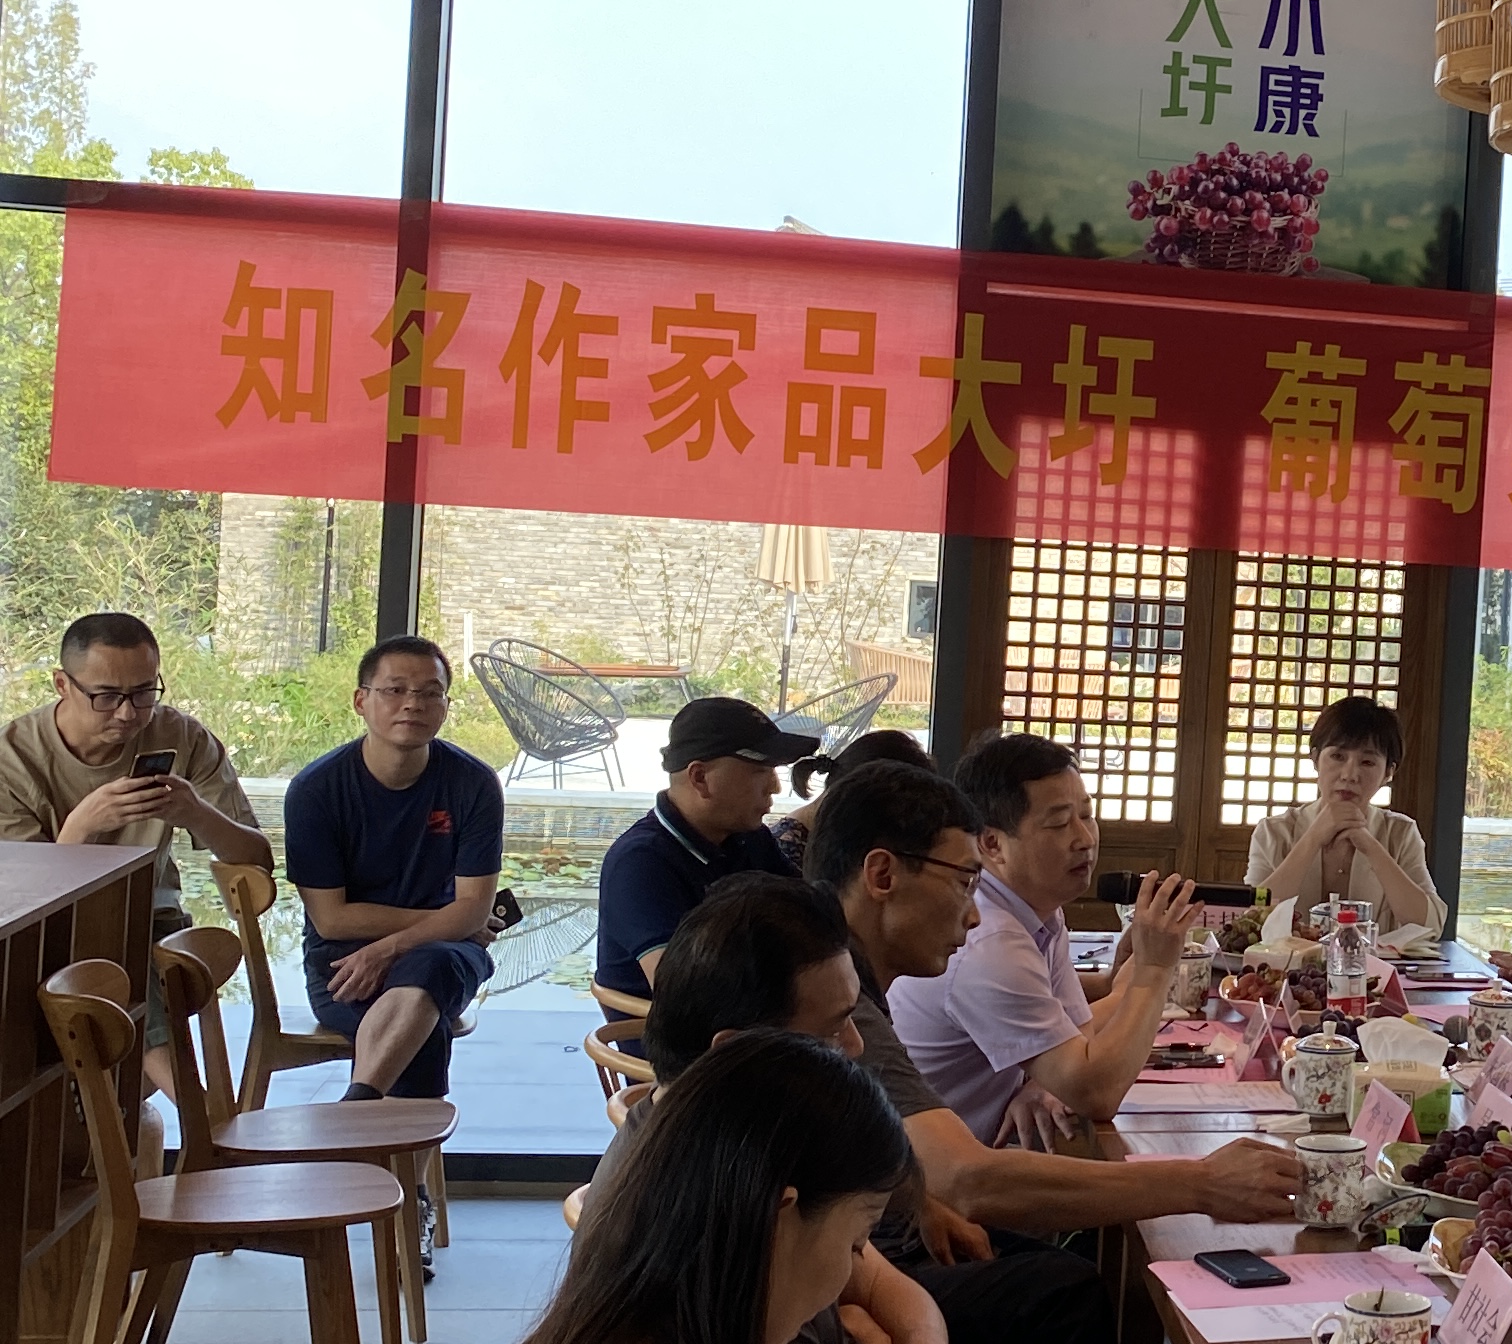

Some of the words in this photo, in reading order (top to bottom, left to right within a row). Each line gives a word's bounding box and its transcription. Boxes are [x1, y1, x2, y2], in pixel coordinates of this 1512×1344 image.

[214, 260, 1157, 486] 知名作家品大圩
